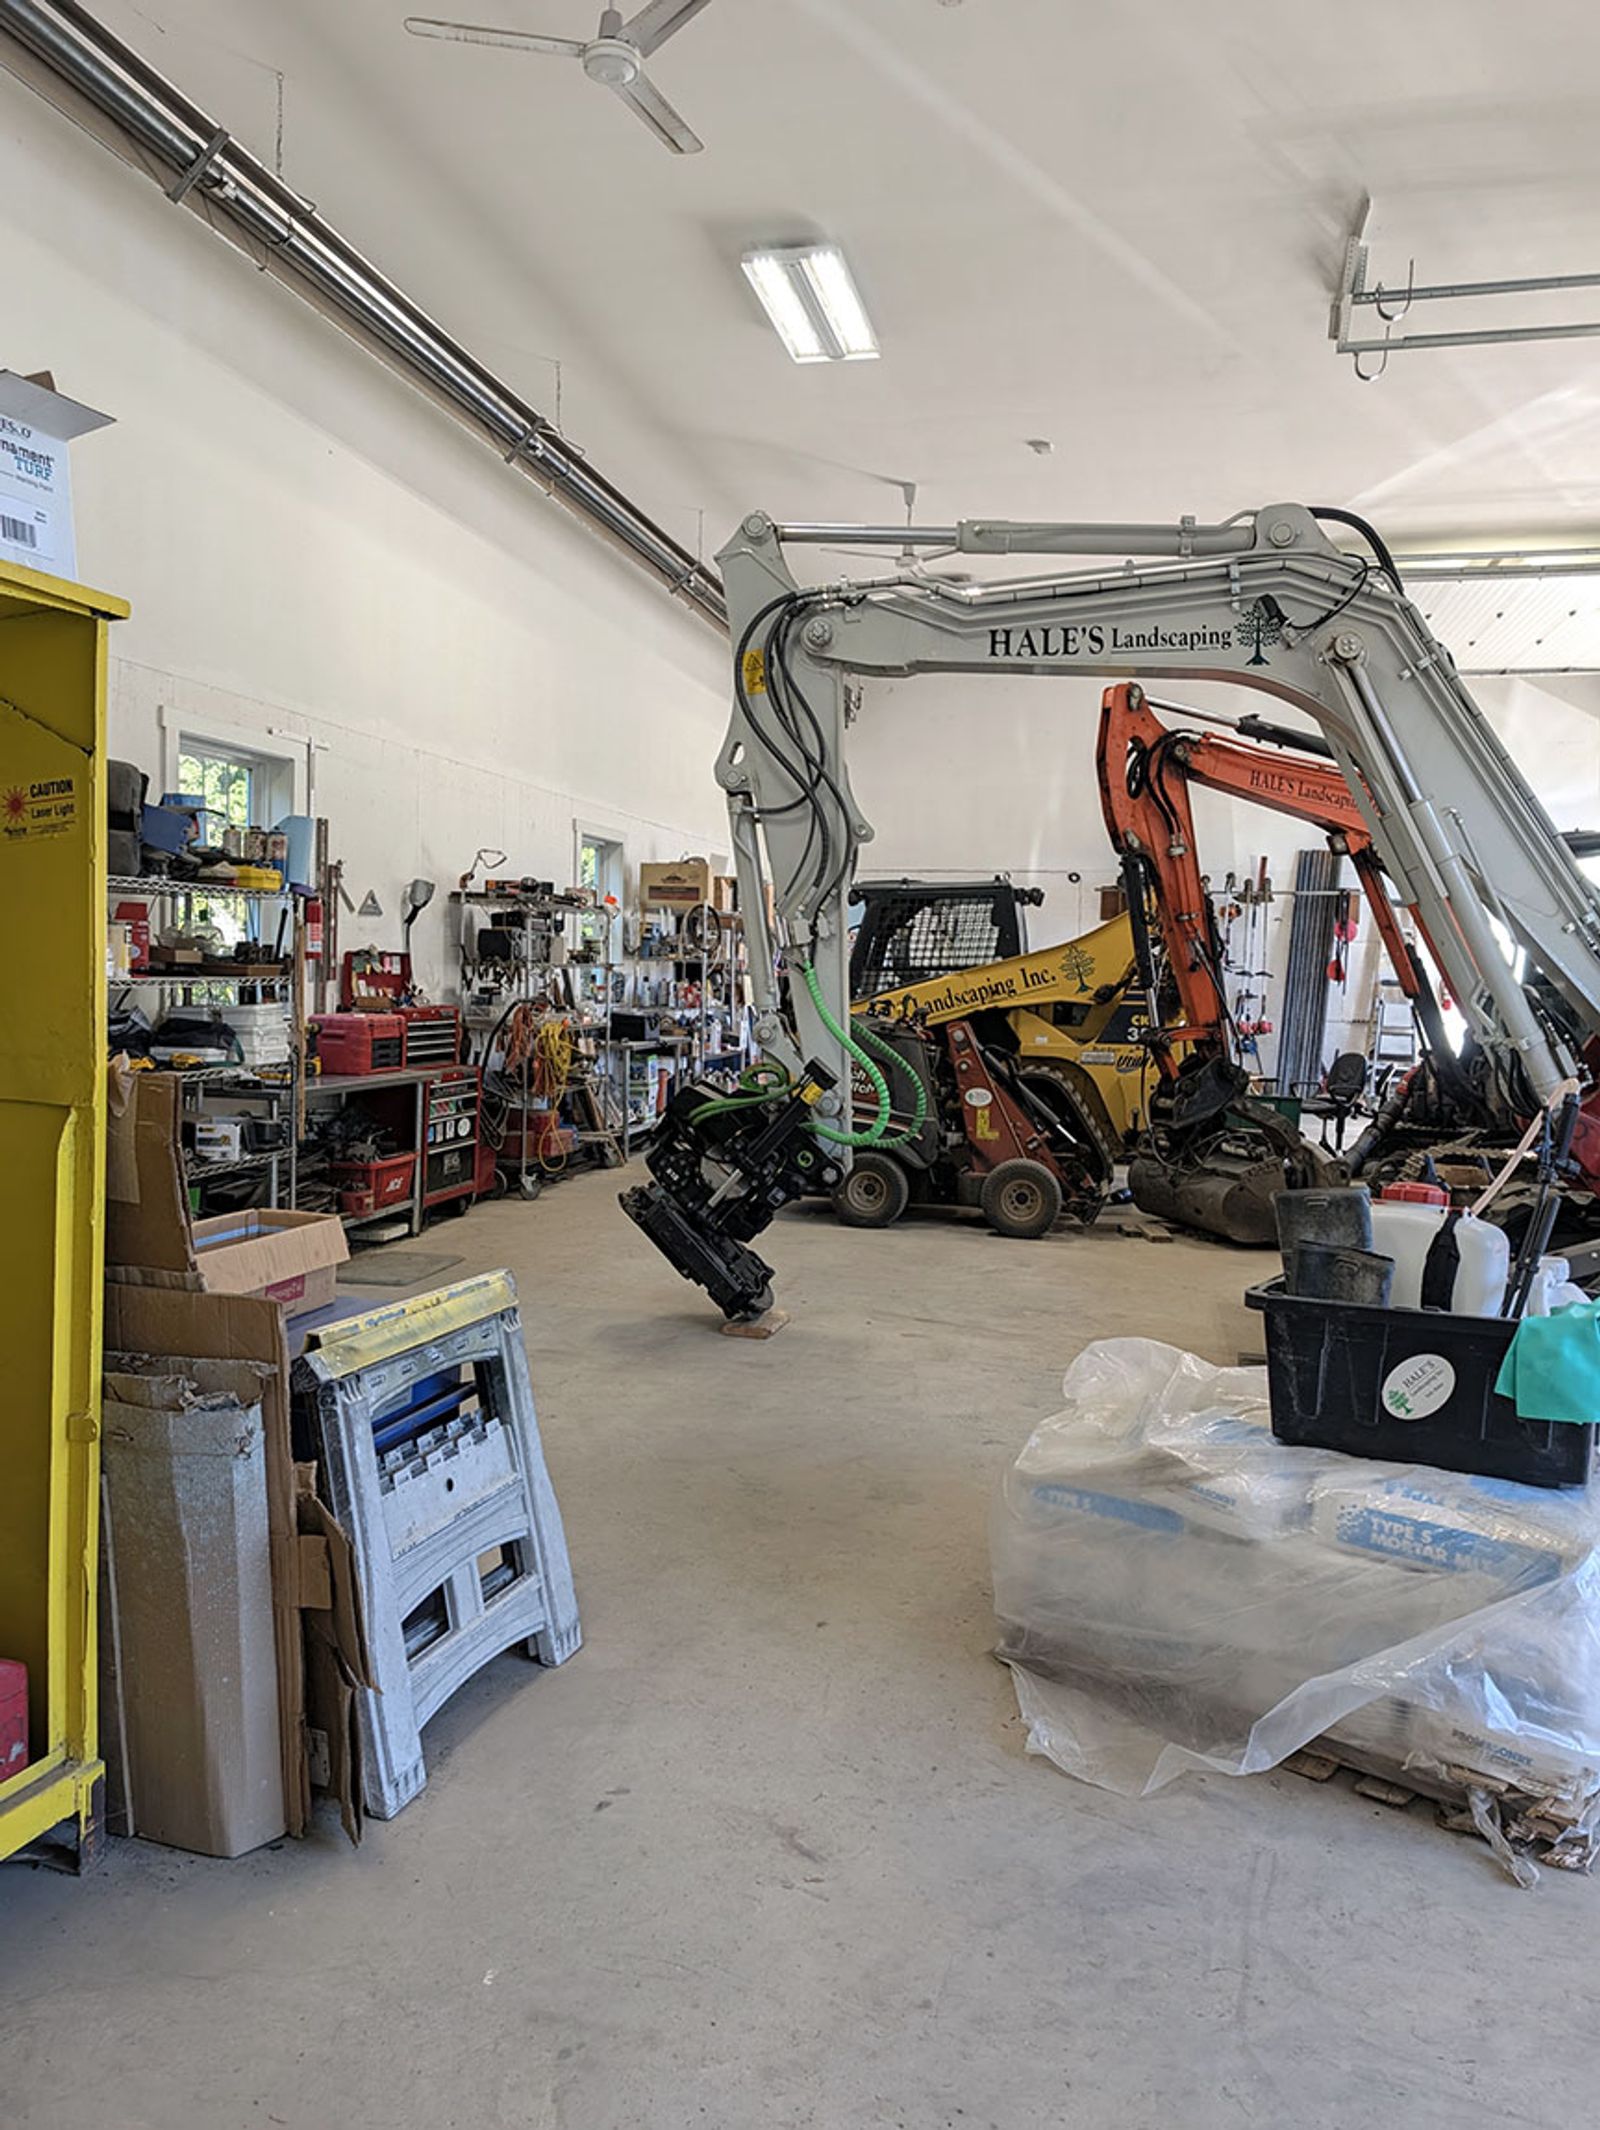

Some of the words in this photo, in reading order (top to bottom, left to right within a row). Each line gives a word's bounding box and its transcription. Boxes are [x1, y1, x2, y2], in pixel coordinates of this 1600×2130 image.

[14, 455, 53, 481] TURF
[989, 626, 1105, 657] HALE'S
[1111, 625, 1232, 650] Landscaping
[30, 779, 74, 798] CAUTION
[1250, 769, 1294, 793] HALE'S
[32, 807, 52, 819] Laser
[54, 803, 75, 817] Light
[1020, 967, 1056, 989] Inc.
[1402, 1360, 1436, 1389] HALE'S
[1371, 1518, 1415, 1541] TYPE
[1420, 1529, 1433, 1544] S
[1370, 1531, 1448, 1562] MORTAR
